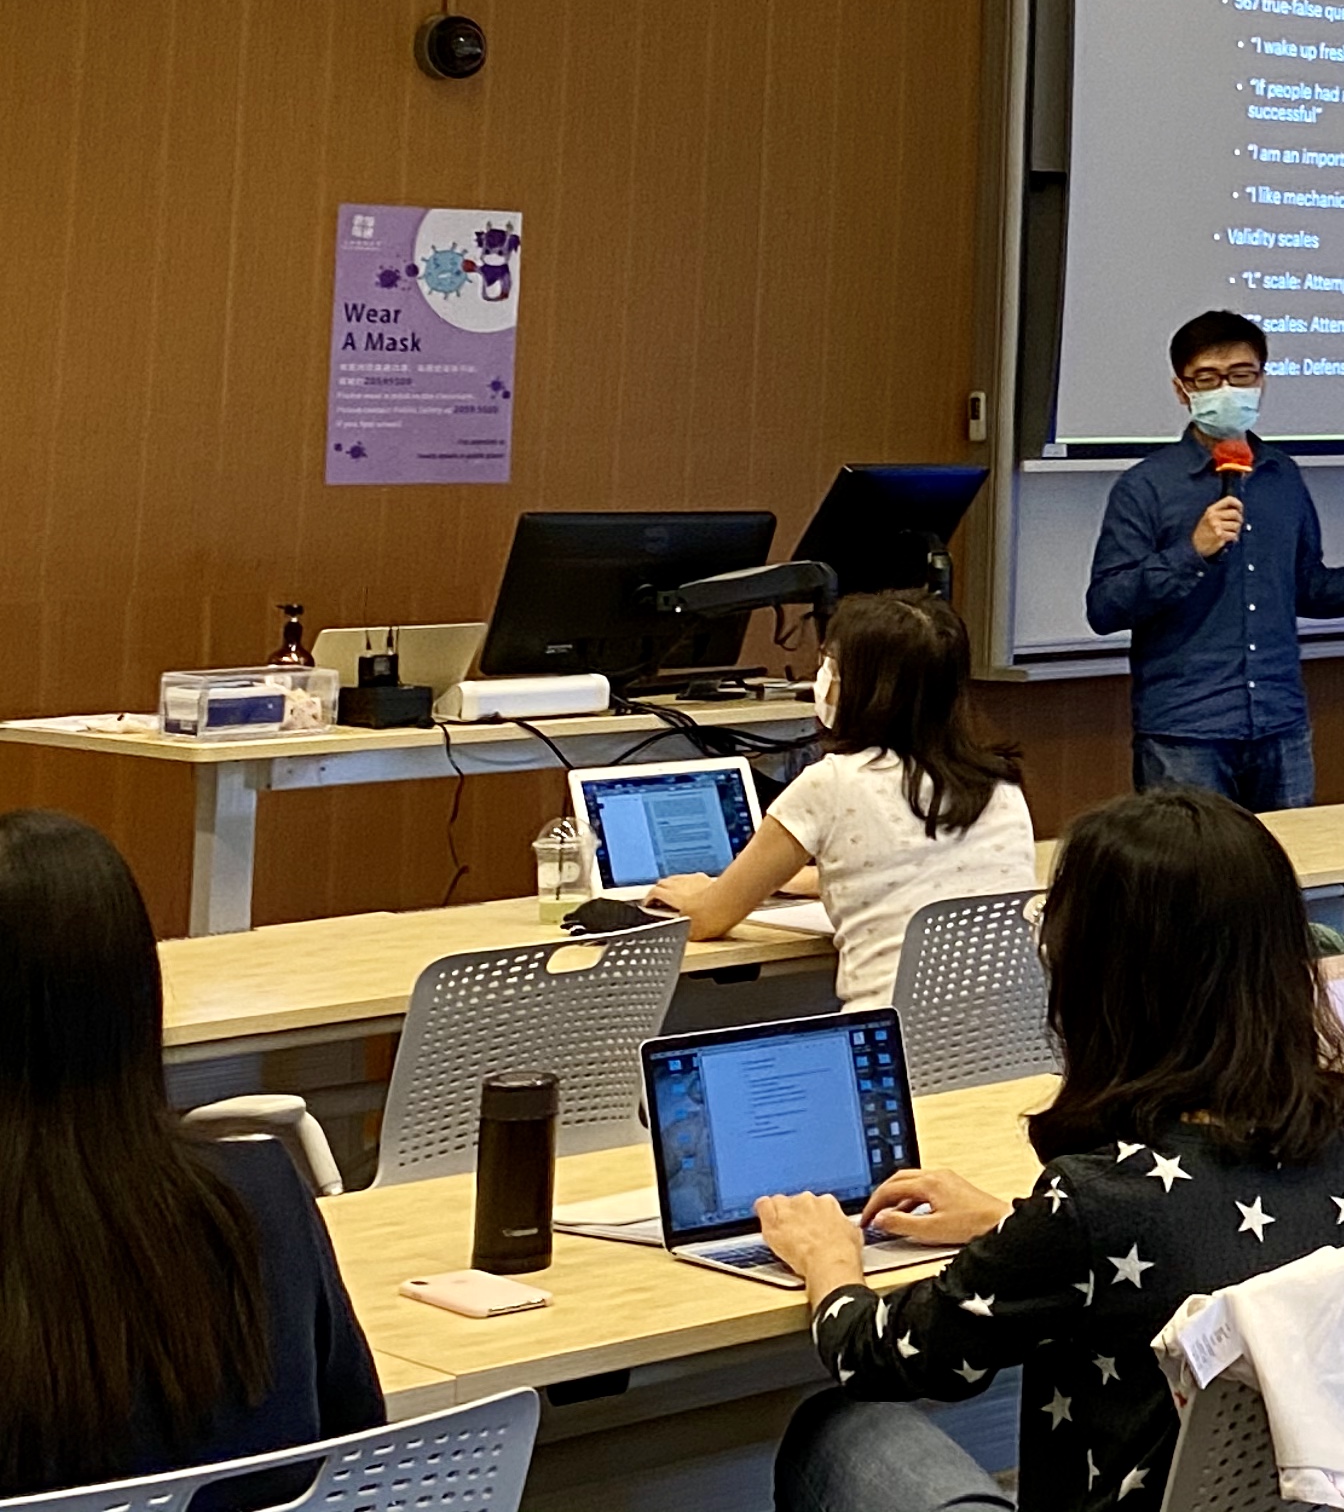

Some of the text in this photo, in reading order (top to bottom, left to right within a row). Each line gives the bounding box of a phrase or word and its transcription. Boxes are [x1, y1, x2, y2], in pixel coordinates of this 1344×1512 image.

[1263, 40, 1298, 58] wake
[1299, 45, 1317, 61] up
[1267, 83, 1312, 101] people
[1314, 83, 1341, 102] had
[1259, 147, 1281, 163] am
[1282, 149, 1300, 164] an
[1257, 185, 1282, 204] like
[1227, 228, 1320, 249] Validity scales
[1263, 272, 1302, 289] scale:
[344, 302, 402, 323] Wear
[1263, 314, 1309, 334] scales:
[342, 331, 422, 352] A Mask
[1264, 359, 1301, 376] scale:
